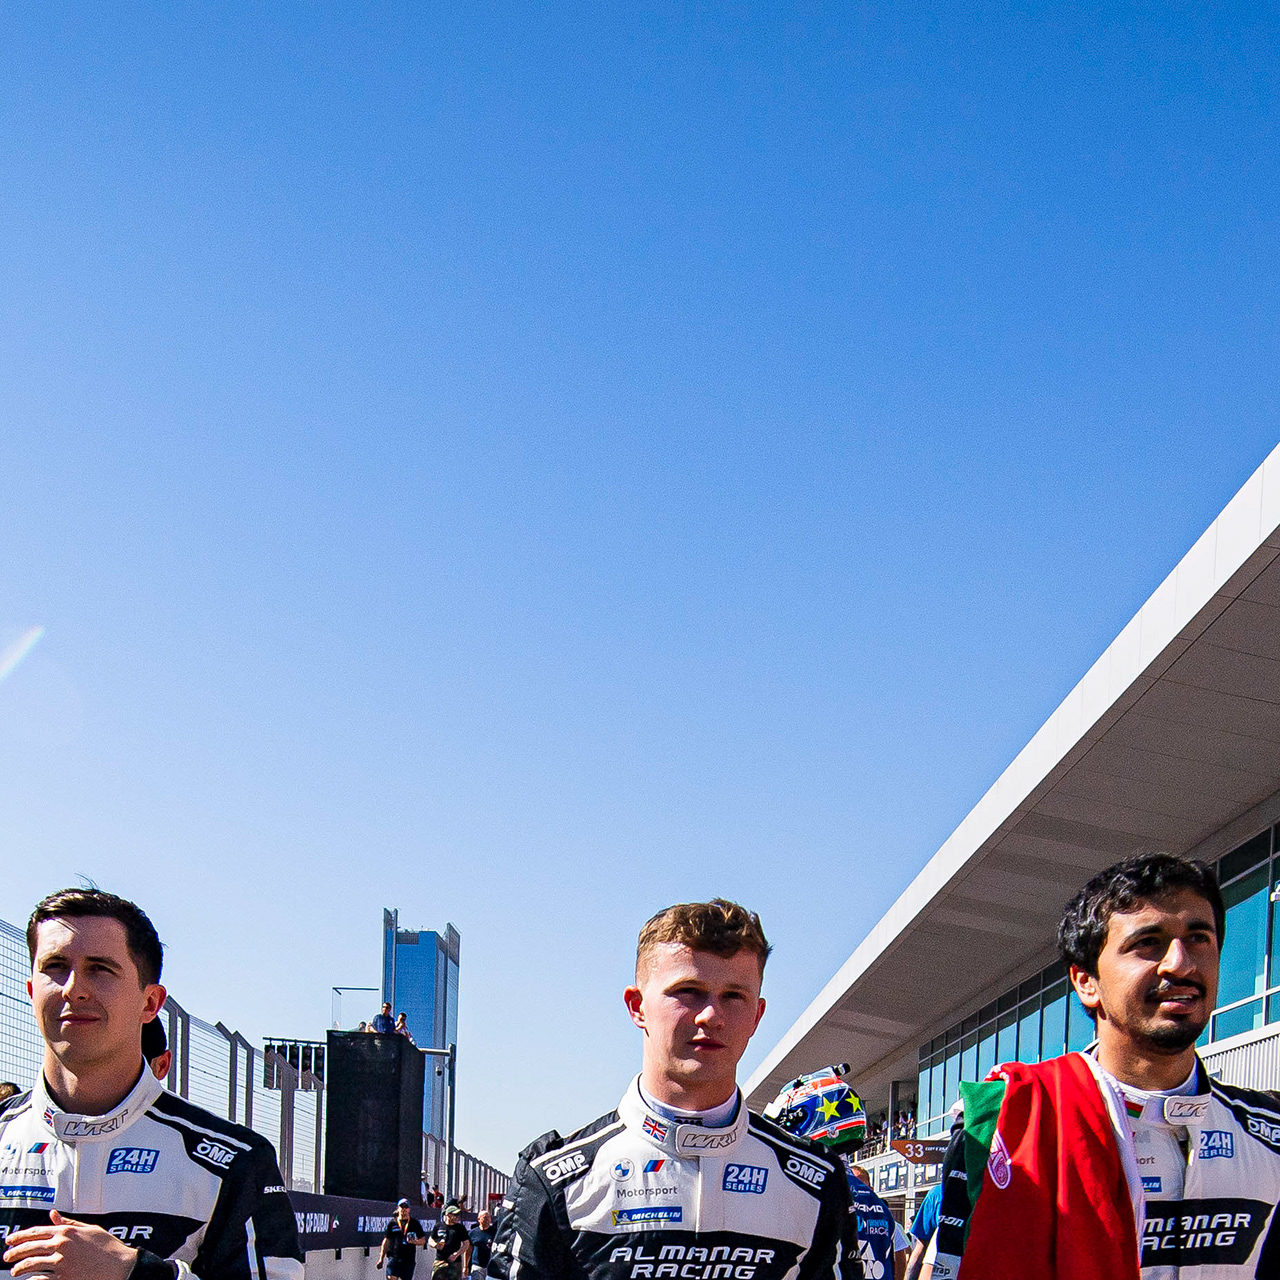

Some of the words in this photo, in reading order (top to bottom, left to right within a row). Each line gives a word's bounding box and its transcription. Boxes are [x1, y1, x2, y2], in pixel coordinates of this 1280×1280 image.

[1201, 1133, 1232, 1149] 24H
[112, 1150, 156, 1165] 24H
[197, 1143, 236, 1165] OMP
[904, 1144, 924, 1158] 33
[1199, 1149, 1233, 1158] SERIES
[109, 1164, 152, 1173] SERIES
[545, 1154, 586, 1179] OMP
[786, 1159, 826, 1184] OMP
[727, 1166, 766, 1185] 24H
[6, 1190, 55, 1199] MICHELIN
[616, 1186, 678, 1199] Motorsport
[725, 1182, 763, 1193] SERIES
[632, 1210, 681, 1220] MICHELIN
[609, 1245, 775, 1263] ALMANAR
[630, 1264, 757, 1280] RACING
